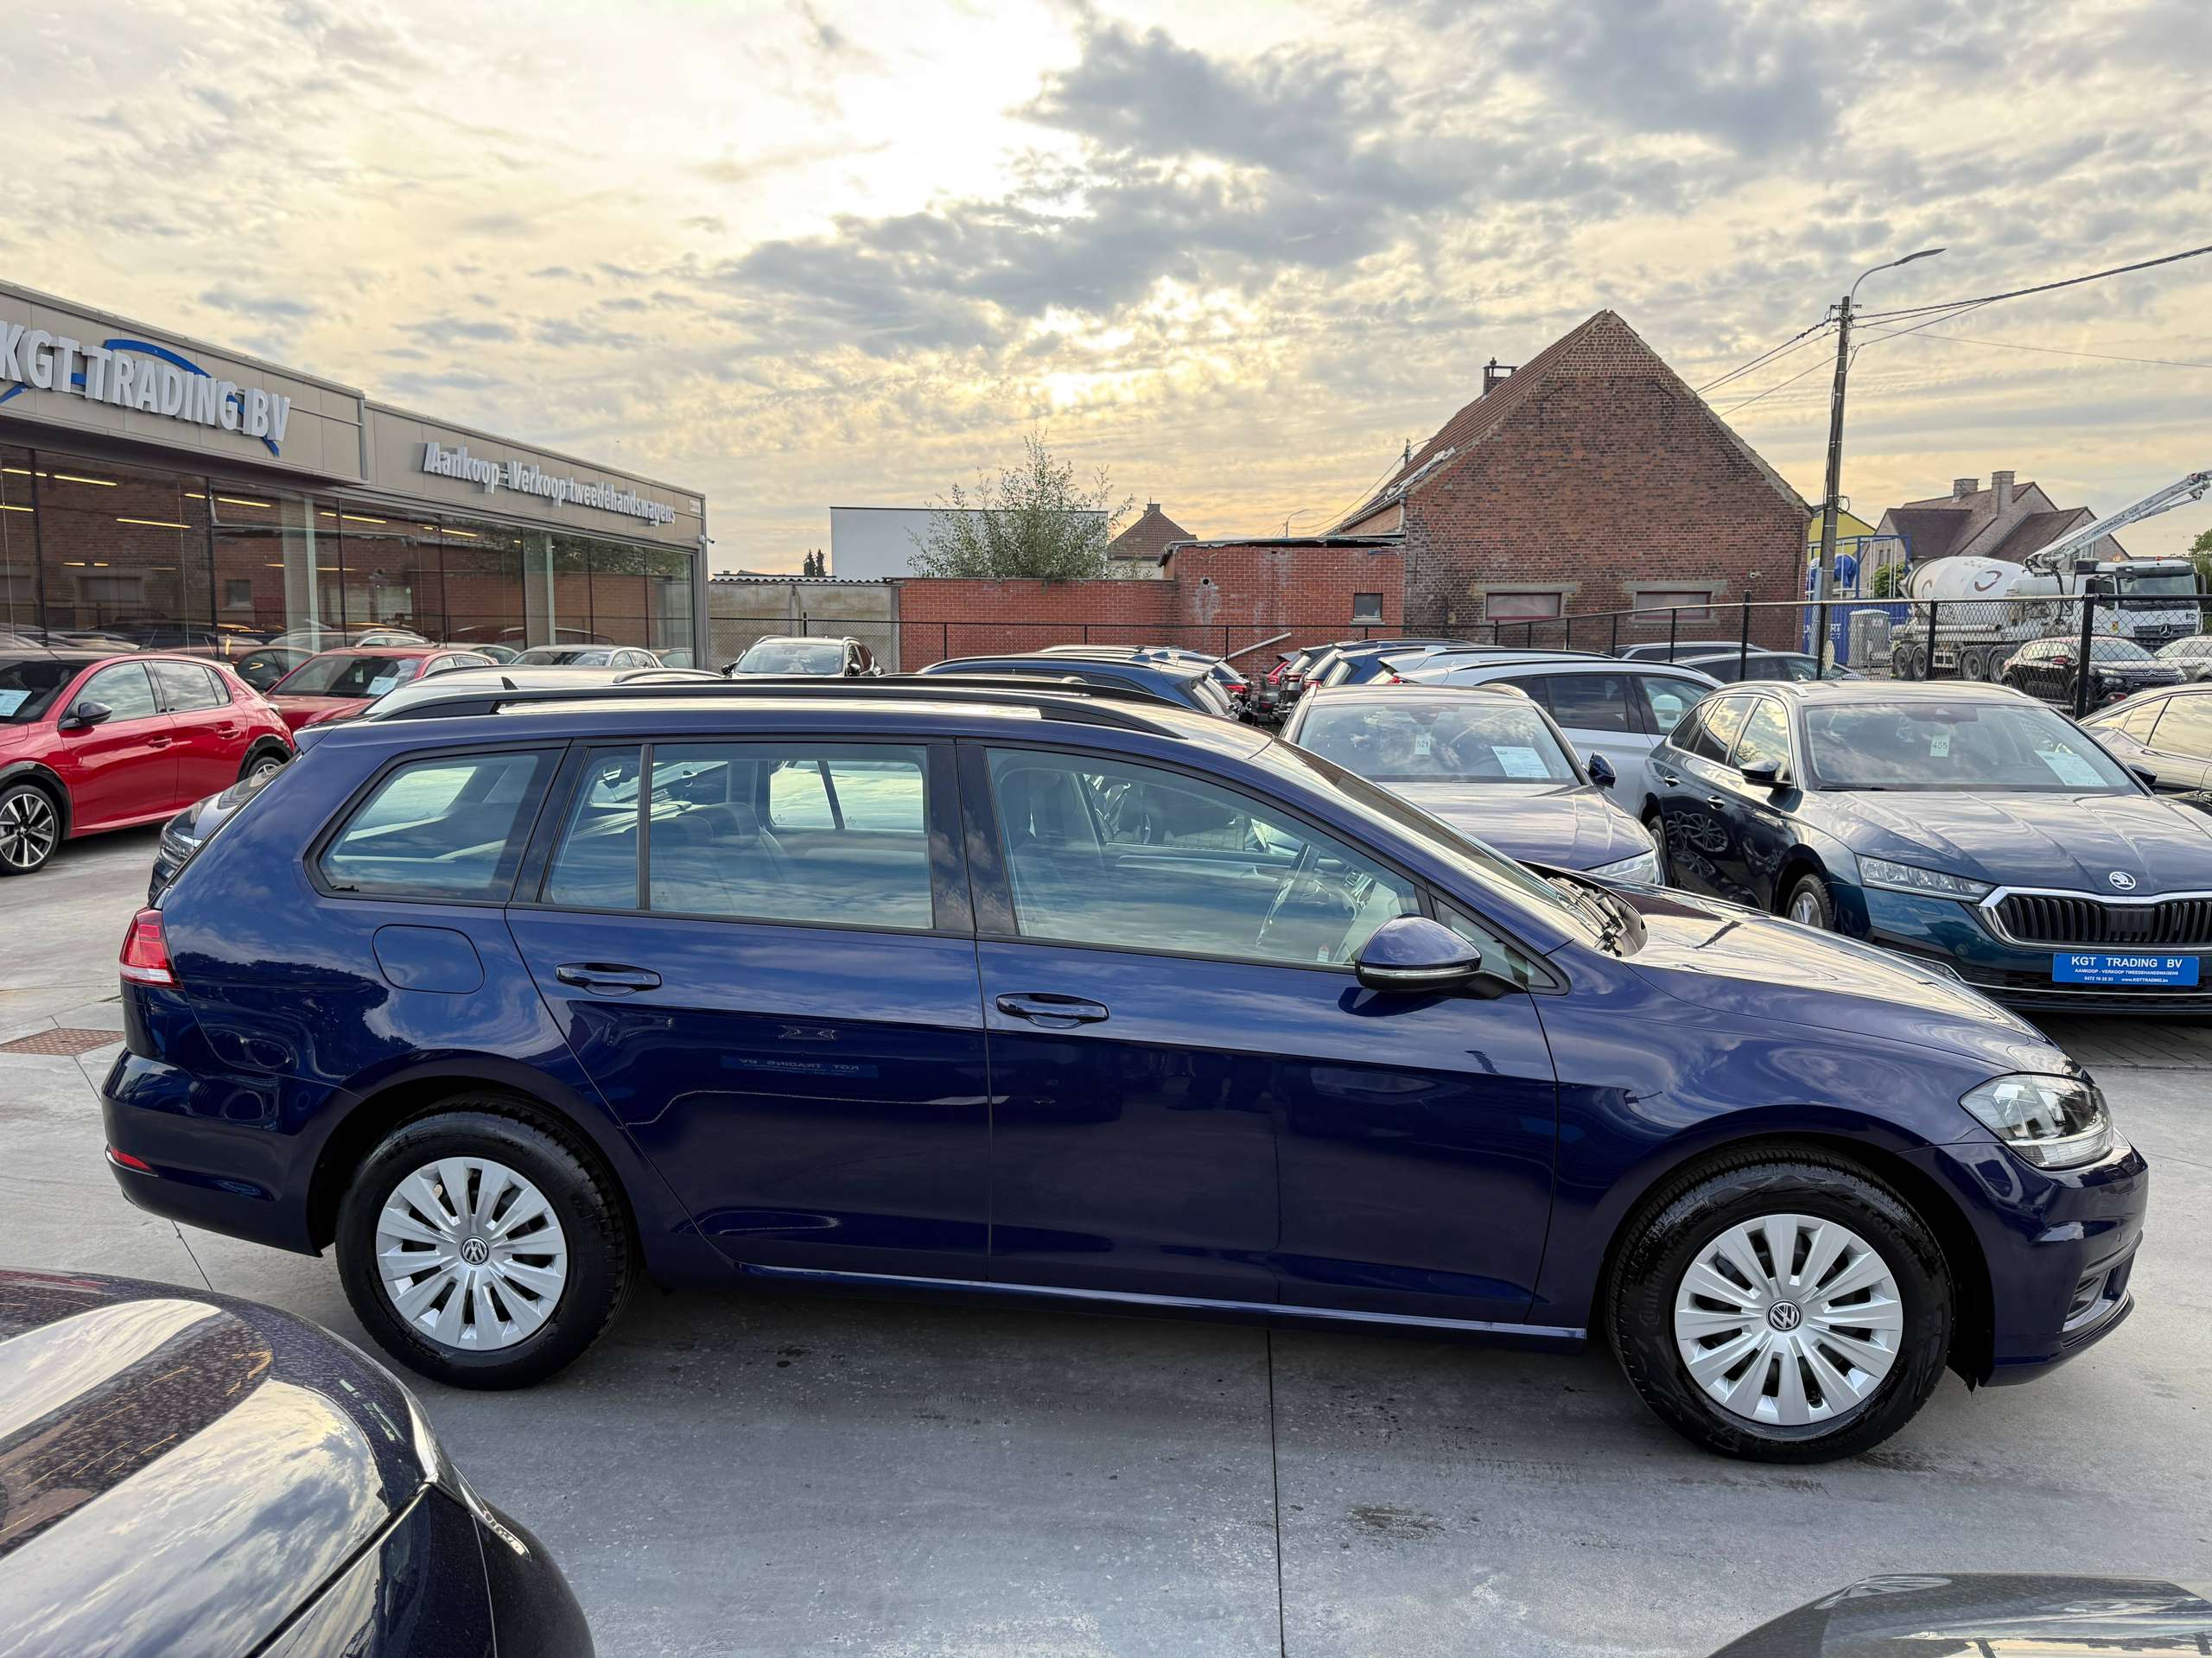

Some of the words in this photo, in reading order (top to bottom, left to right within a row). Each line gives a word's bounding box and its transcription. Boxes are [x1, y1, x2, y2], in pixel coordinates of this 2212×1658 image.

[0, 320, 79, 394] KGT
[86, 346, 238, 430] TRADING
[244, 386, 291, 442] BV
[423, 441, 500, 494] Aankoop
[508, 461, 567, 507] Verkoop
[568, 477, 676, 527] tweedehandswagens
[2071, 956, 2097, 966] KGT
[2106, 957, 2158, 968] TRADING
[2166, 959, 2183, 969] BV
